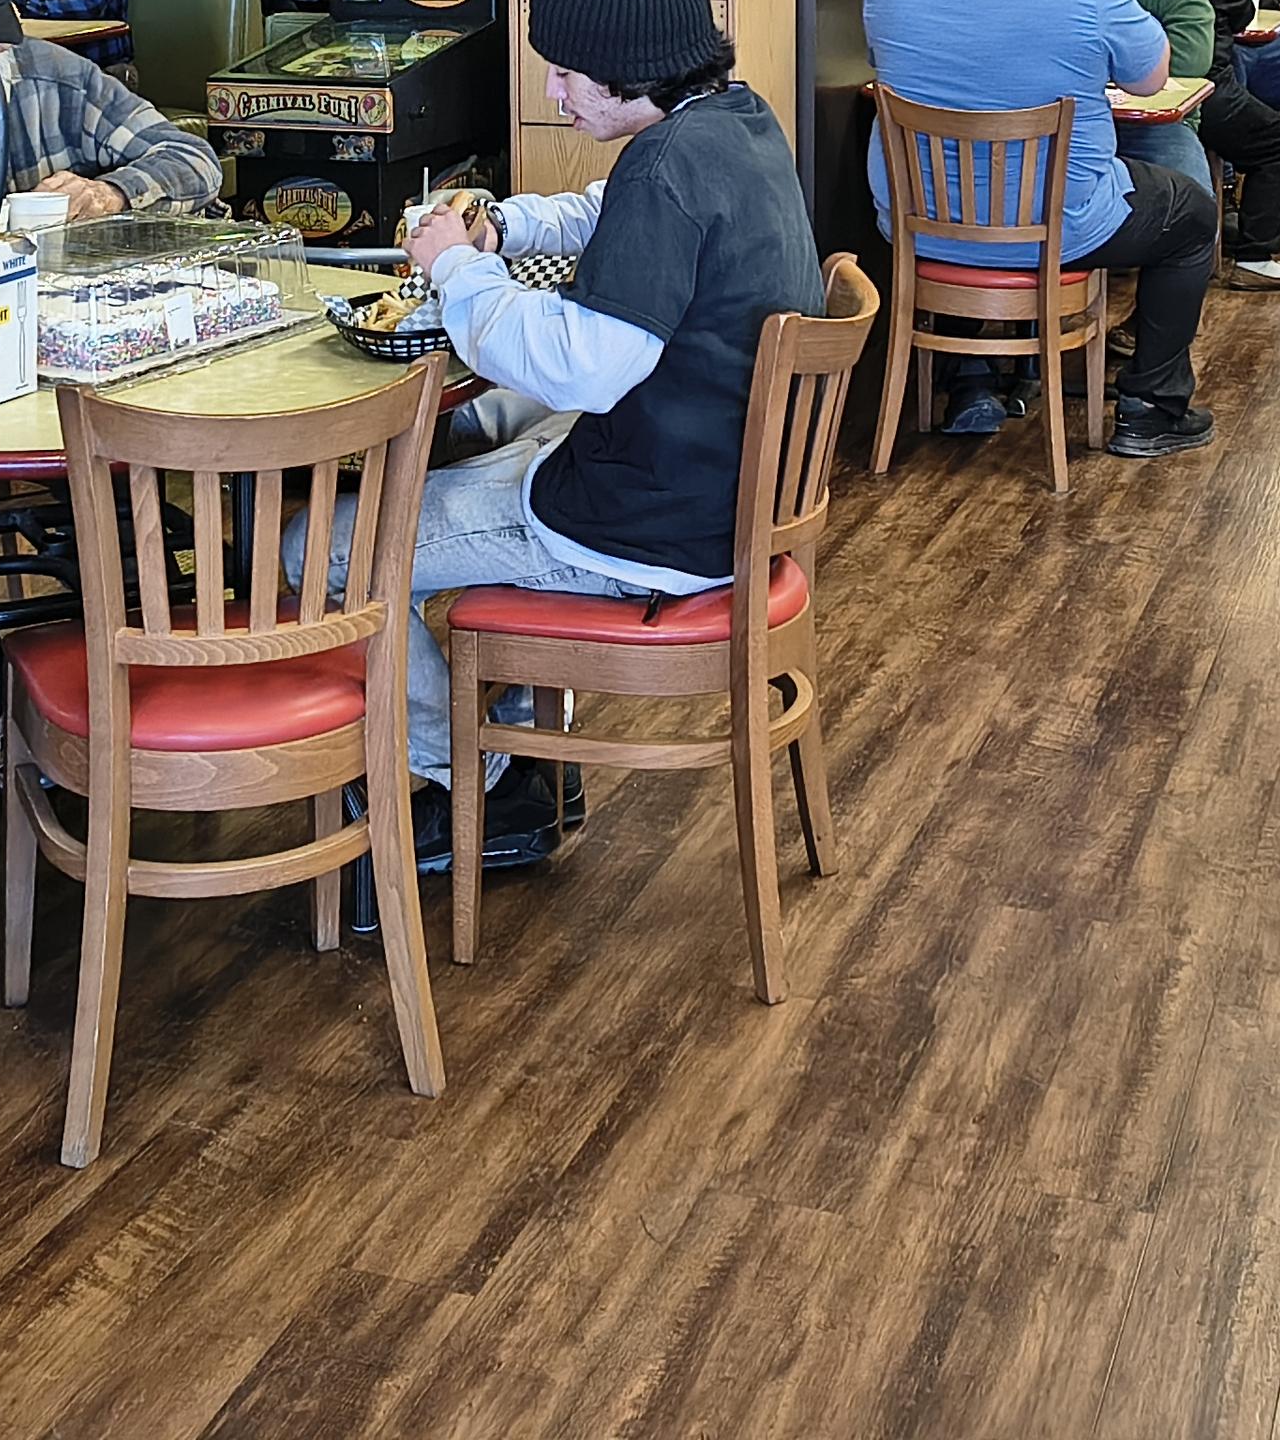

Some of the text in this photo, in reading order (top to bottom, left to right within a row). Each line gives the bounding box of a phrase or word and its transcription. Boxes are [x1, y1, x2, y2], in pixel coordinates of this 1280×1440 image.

[238, 92, 359, 126] CARNIVAL FUN!
[276, 186, 317, 215] CARNIVAL
[3, 256, 27, 271] WHITE
